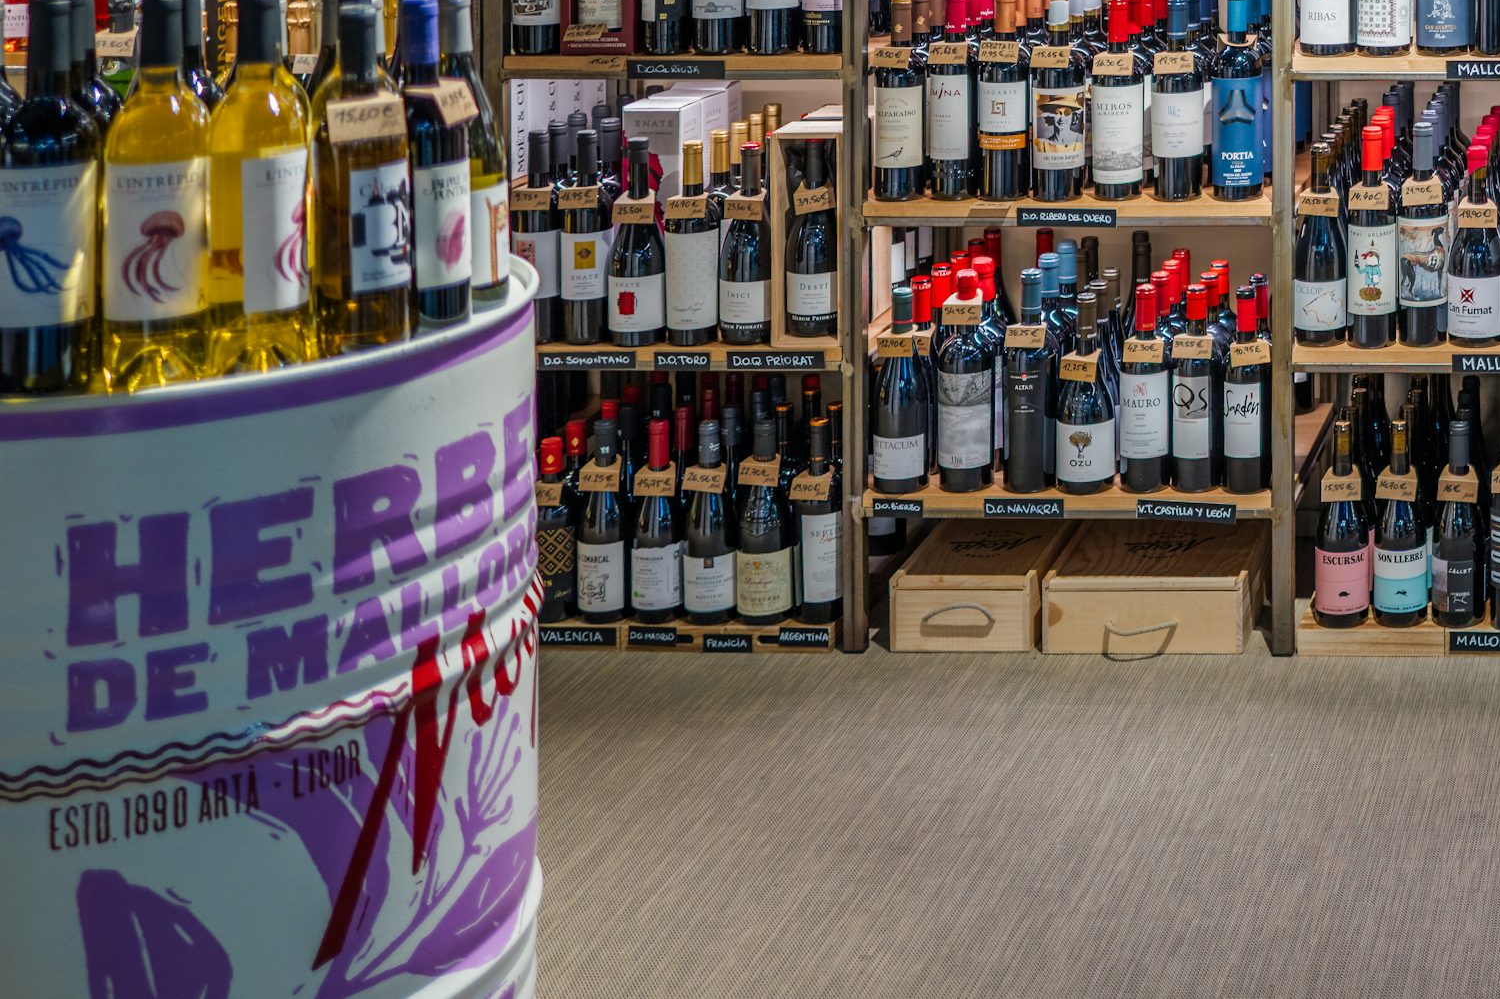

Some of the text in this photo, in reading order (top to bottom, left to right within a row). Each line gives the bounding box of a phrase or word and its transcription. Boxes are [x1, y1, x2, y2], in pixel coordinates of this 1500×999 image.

[1308, 11, 1336, 20] RIBAS
[635, 120, 674, 128] ENATE
[1221, 152, 1253, 160] PORTIA
[1462, 304, 1492, 315] Fumat
[543, 355, 630, 365] D.O. SOMONTANO
[676, 355, 707, 365] TORO
[1123, 398, 1160, 406] MAURO
[1070, 459, 1092, 467] OZU
[986, 504, 1059, 514] D.O. NAVARRA
[65, 397, 538, 647] HERBE
[1323, 554, 1364, 564] ESCURSAC
[1378, 551, 1423, 563] SON LLEBRE
[541, 631, 602, 642] VALENCIA
[66, 643, 209, 732] DE
[50, 801, 117, 850] ESTD.
[123, 786, 189, 836] 1890
[293, 740, 361, 799] LICOR
